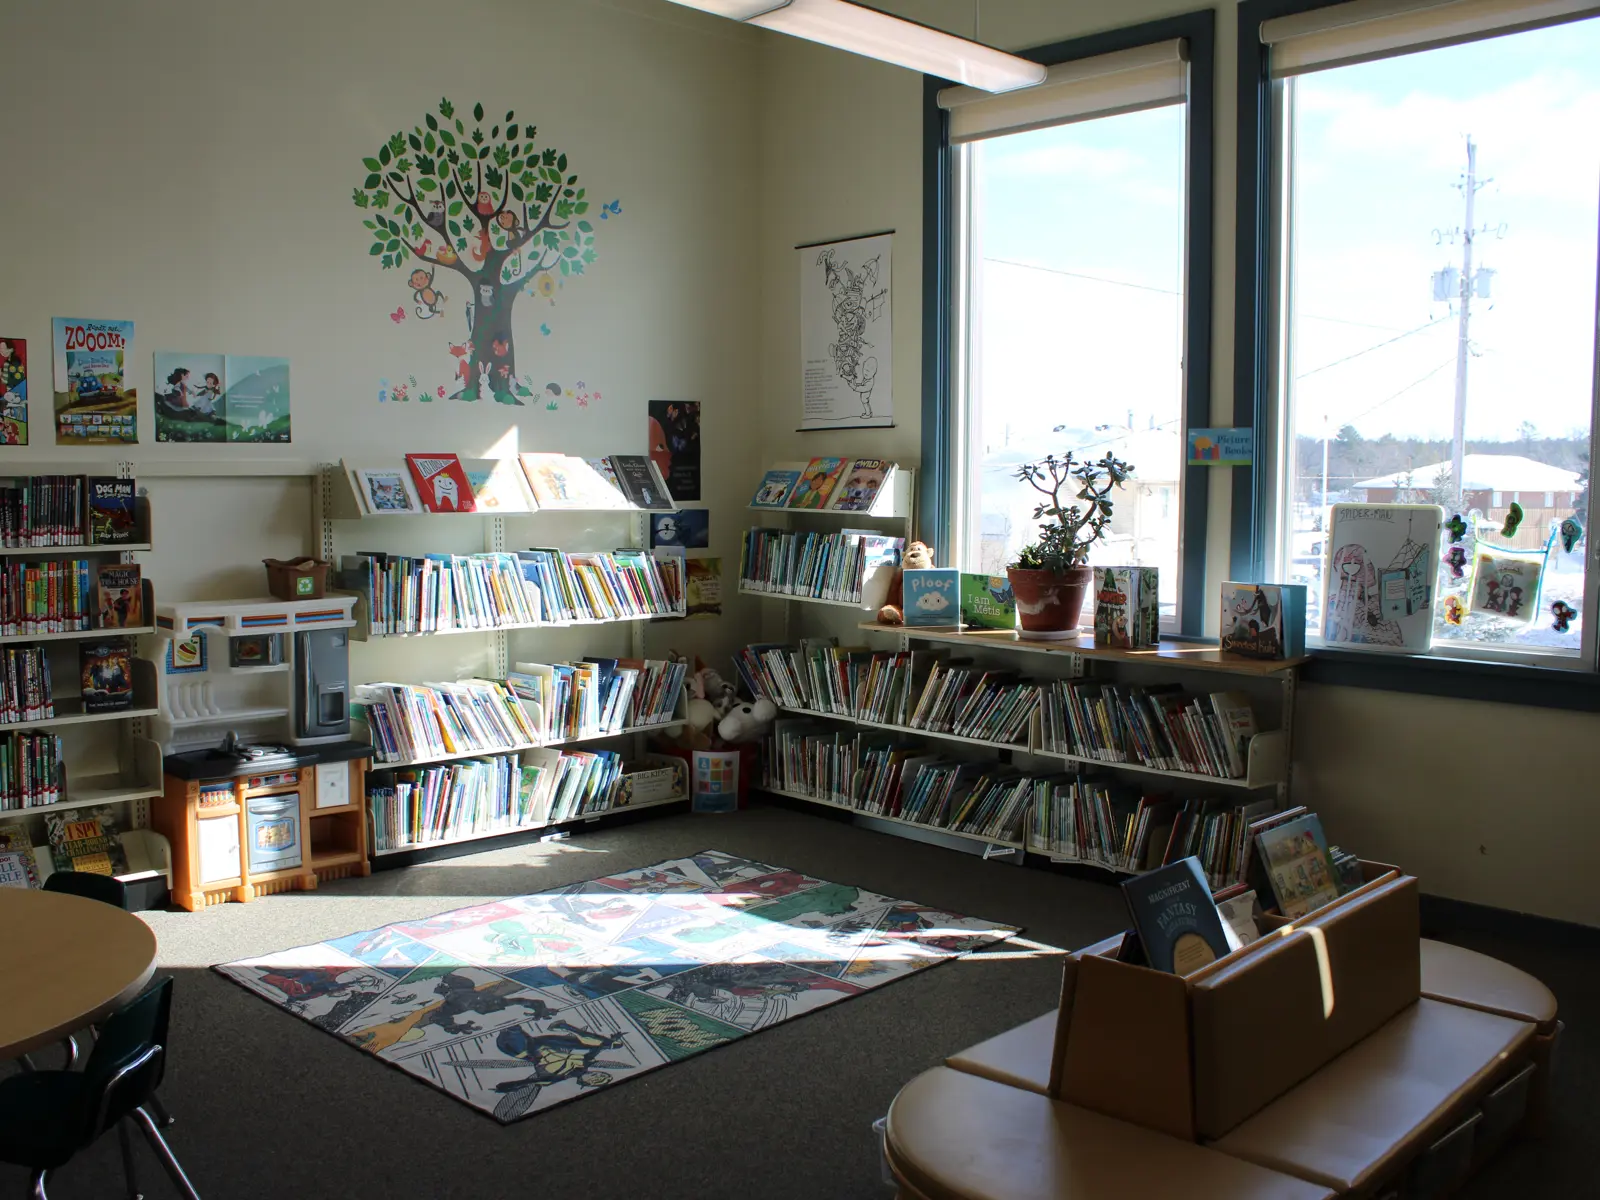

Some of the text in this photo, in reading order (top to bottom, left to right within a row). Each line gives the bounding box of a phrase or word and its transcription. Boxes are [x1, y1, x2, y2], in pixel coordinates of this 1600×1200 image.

[65, 325, 126, 352] ZOOOM!
[861, 460, 880, 469] WILD
[95, 484, 132, 494] DOG MAN
[1340, 508, 1394, 520] SPIDER-MAN
[911, 576, 954, 592] ploof
[968, 594, 990, 605] I am
[974, 604, 1001, 616] Métis
[637, 771, 650, 780] BIG
[76, 821, 97, 838] SPY
[1157, 902, 1198, 930] FANTASY
